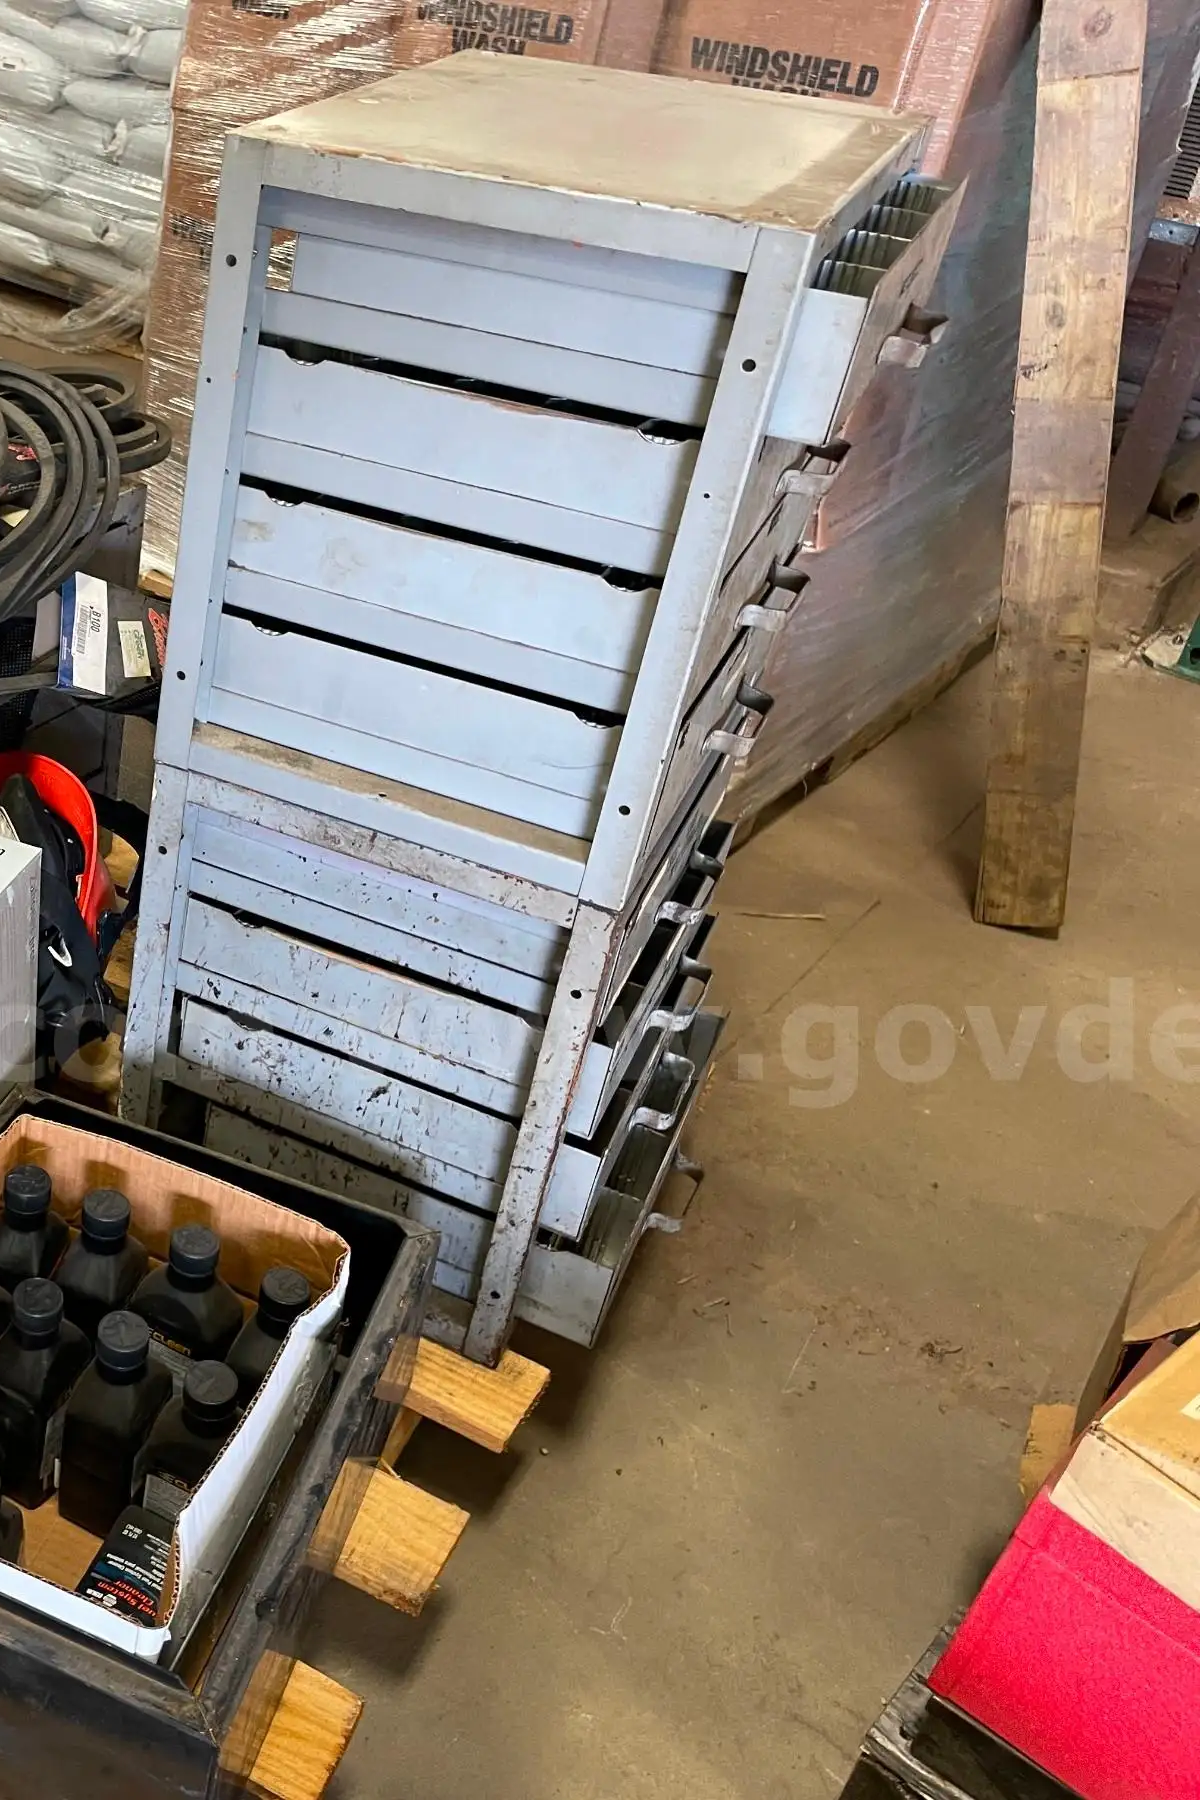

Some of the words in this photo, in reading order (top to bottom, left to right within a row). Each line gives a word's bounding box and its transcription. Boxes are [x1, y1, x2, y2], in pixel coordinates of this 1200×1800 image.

[691, 37, 880, 98] WINDSHIELD
[97, 1581, 137, 1607] System
[114, 1580, 154, 1606] Cleaner
[138, 1603, 156, 1617] uel
